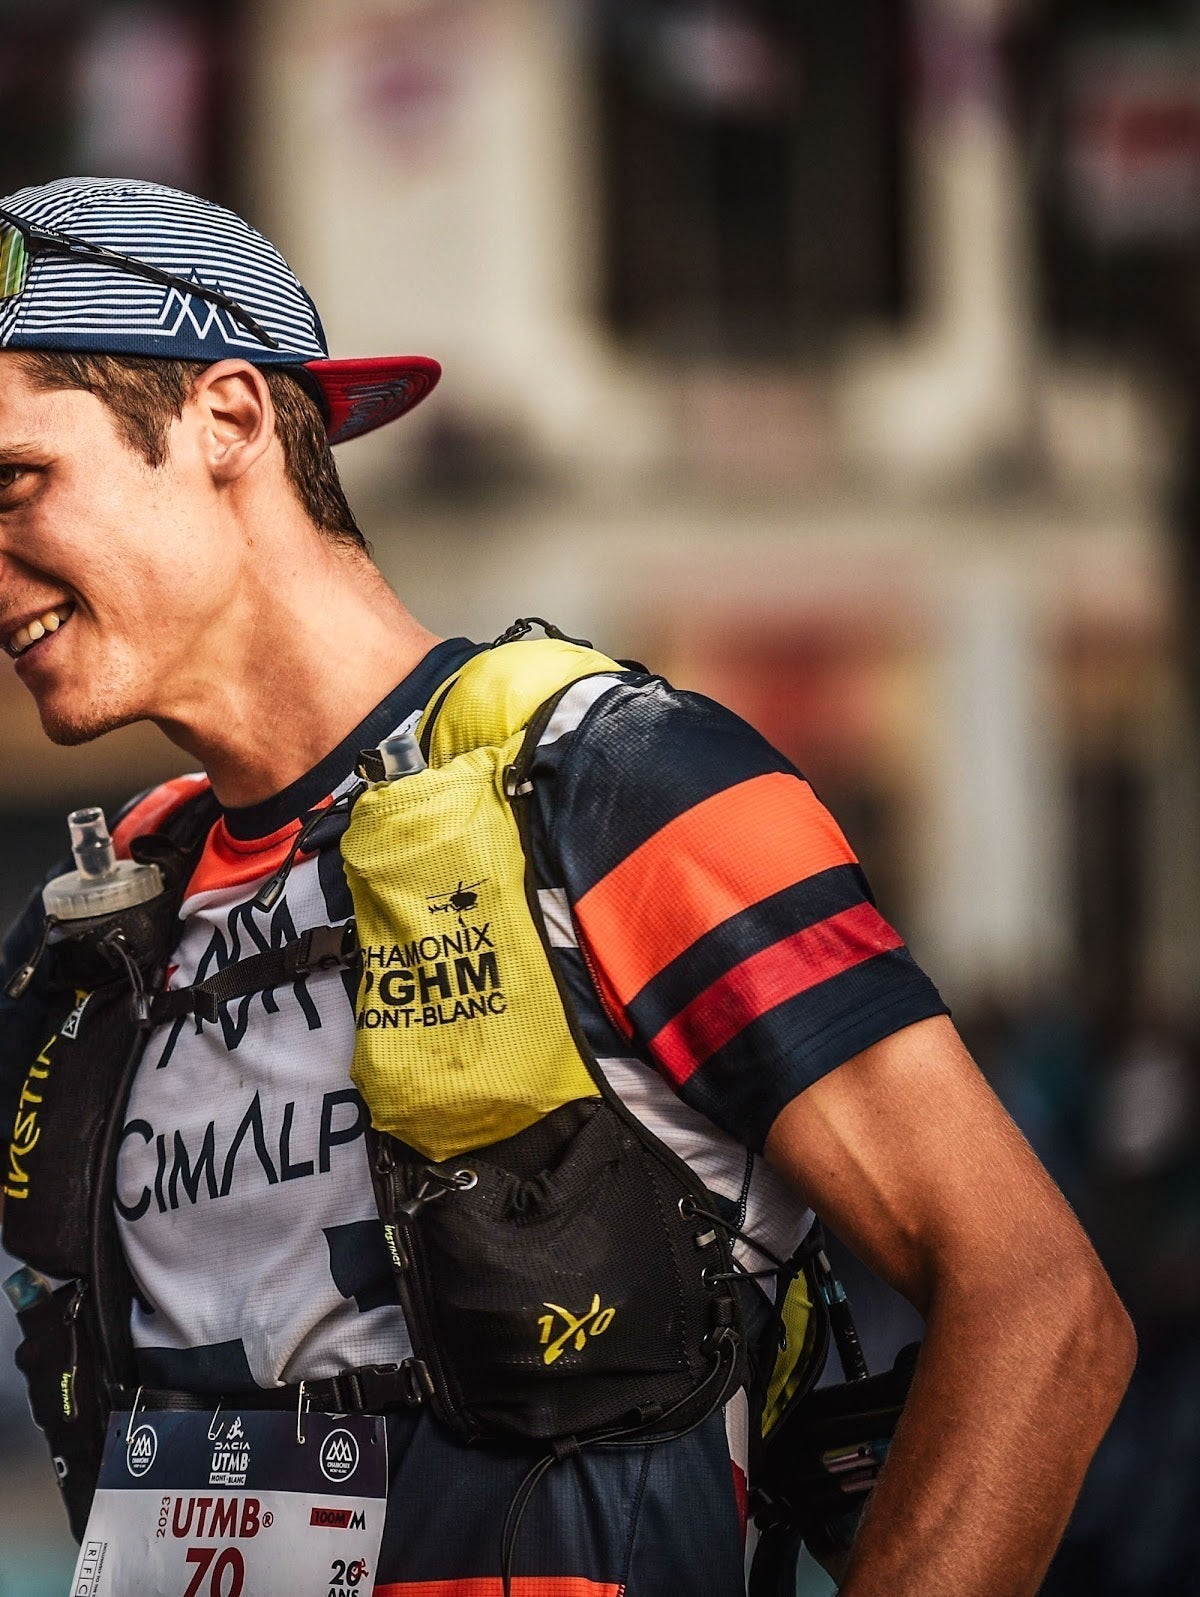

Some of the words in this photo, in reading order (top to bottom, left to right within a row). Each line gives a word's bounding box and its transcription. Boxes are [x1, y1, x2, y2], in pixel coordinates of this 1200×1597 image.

[114, 1088, 372, 1222] CIMALP
[214, 1441, 251, 1450] DACIA
[156, 1496, 171, 1538] 2023
[183, 1547, 245, 1597] 70
